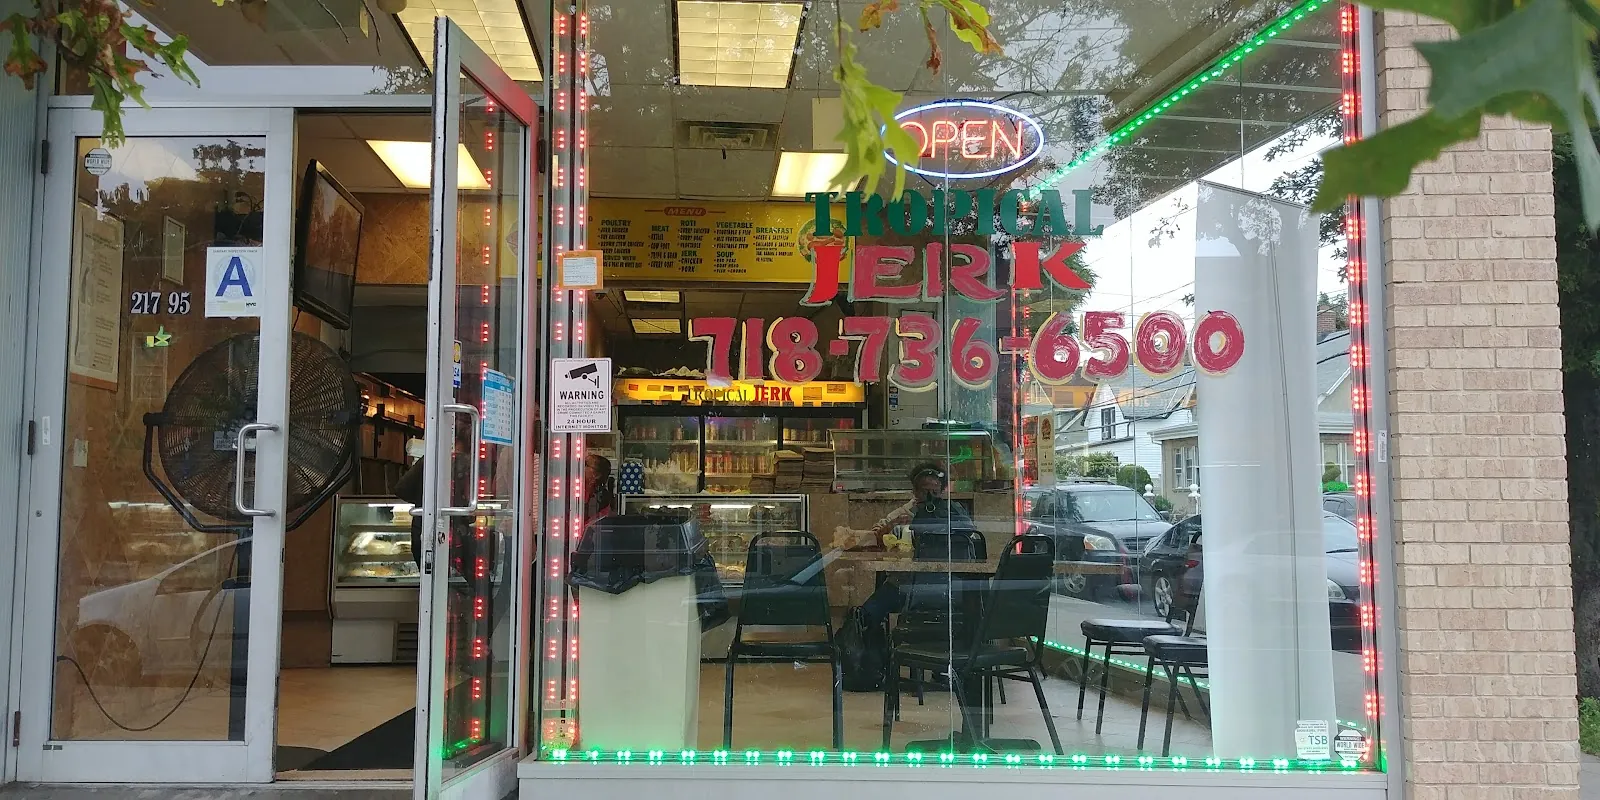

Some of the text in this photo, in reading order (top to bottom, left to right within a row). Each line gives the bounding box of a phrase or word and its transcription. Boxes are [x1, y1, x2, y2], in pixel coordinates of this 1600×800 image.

[668, 208, 703, 216] MENU
[805, 189, 1103, 237] TROPICAL
[215, 256, 253, 297] A
[799, 242, 1097, 306] JERK
[130, 292, 161, 314] 217
[168, 292, 191, 314] 95
[560, 390, 604, 400] WARNING
[689, 385, 792, 402] TROPICAL JERK
[1308, 735, 1328, 745] TSB
